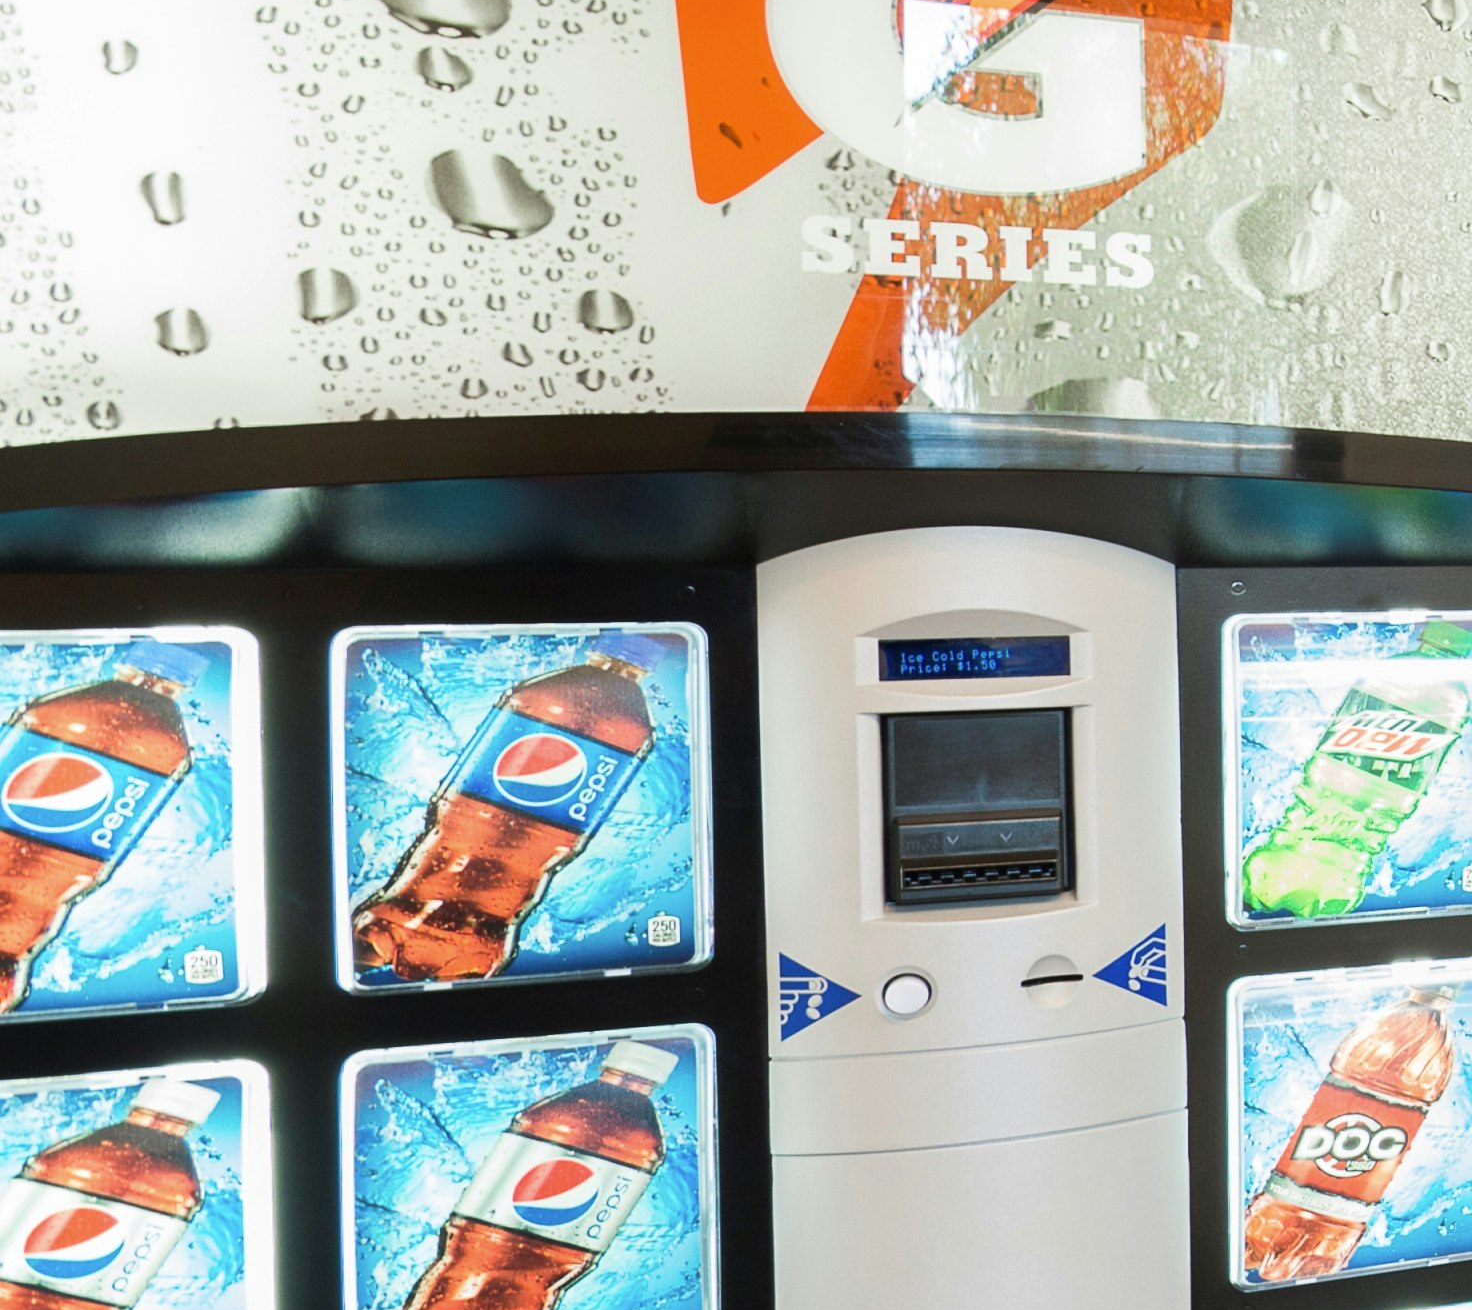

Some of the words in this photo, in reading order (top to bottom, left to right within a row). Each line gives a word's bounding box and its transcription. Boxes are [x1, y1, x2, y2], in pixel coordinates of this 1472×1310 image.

[800, 214, 1155, 289] SERIES
[900, 663, 946, 675] Price:
[957, 659, 997, 672] $1.50
[901, 652, 924, 664] Ice
[932, 650, 965, 662] Cold
[972, 647, 1011, 659] Pepsi
[91, 776, 152, 849] pepsi
[568, 753, 618, 823] pepsi
[652, 919, 677, 933] 250
[190, 954, 218, 968] 250
[1290, 1126, 1409, 1161] DOC
[585, 1173, 635, 1241] pepsi
[111, 1221, 170, 1293] pepsi
